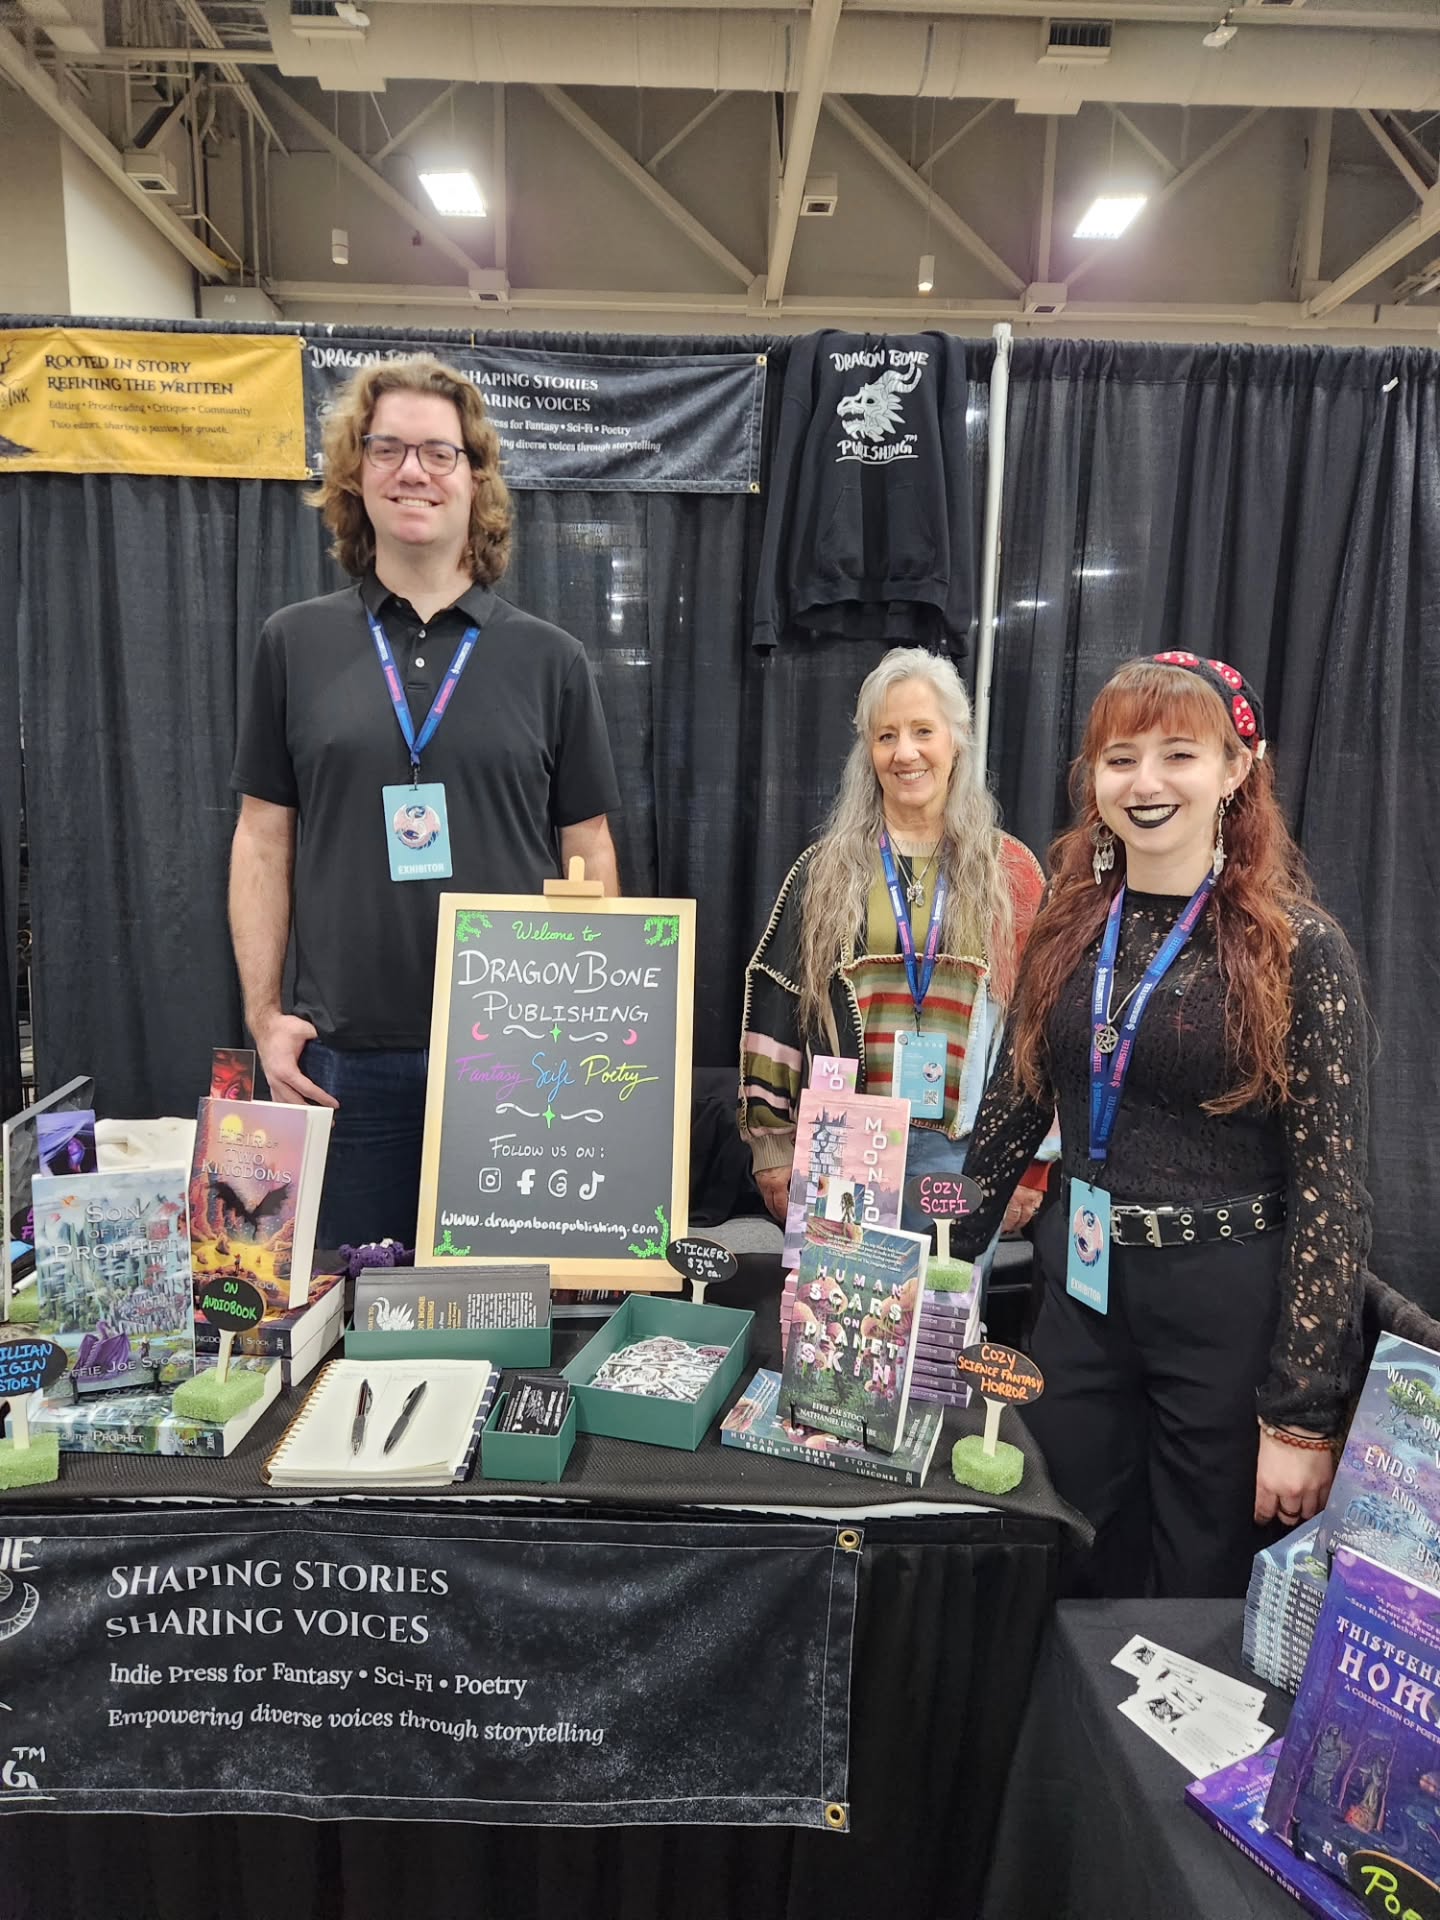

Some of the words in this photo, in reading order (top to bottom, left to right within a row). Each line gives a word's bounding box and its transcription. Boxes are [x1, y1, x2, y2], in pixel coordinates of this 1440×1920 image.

[44, 354, 109, 370] ROOTED
[113, 358, 132, 370] IN
[137, 359, 191, 374] STORY
[307, 345, 379, 370] DRAGON
[829, 350, 886, 373] DRAGON
[888, 349, 930, 368] BONE
[47, 376, 122, 392] REFINING
[123, 377, 156, 392] THE
[160, 378, 233, 395] WRITTEN
[461, 370, 530, 388] SHAPING
[532, 374, 599, 391] STORIES
[8, 386, 30, 407] INK
[481, 392, 531, 410] ARING
[534, 395, 591, 412] VOICES
[48, 400, 80, 412] Editing
[88, 401, 145, 416] Proofreading
[153, 403, 189, 417] Critique
[198, 406, 252, 419] Community
[509, 417, 524, 430] for
[525, 419, 560, 435] Fantasy
[567, 422, 593, 434] Sci-Fi
[601, 424, 632, 436] Poetry
[515, 438, 547, 451] diverse
[549, 441, 576, 452] voices
[577, 441, 611, 454] through
[612, 438, 662, 454] storytelling
[398, 863, 445, 875] EXHIBITOR
[512, 921, 576, 942] Welcome
[582, 924, 602, 942] to
[457, 949, 580, 986] DRAGON
[574, 950, 662, 994] BONE
[472, 990, 649, 1024] PUBLISHING
[455, 1053, 534, 1100] Fantasy
[580, 1054, 660, 1101] Poetry
[217, 1128, 264, 1149] HEIR
[489, 1133, 544, 1159] FOLLOW
[551, 1145, 568, 1158] US
[224, 1147, 265, 1166] TWO
[201, 1158, 292, 1185] KINGDOMS
[85, 1203, 143, 1223] SON
[87, 1228, 109, 1240] OF
[114, 1225, 147, 1239] THE
[440, 1210, 660, 1241] www.dragonbonepublishing.com
[53, 1239, 178, 1263] PROPHET
[675, 1240, 731, 1264] STICKERS
[223, 1281, 239, 1295] ON
[817, 1263, 904, 1299] HUMAN
[202, 1294, 257, 1321] AUDIOBOOK
[809, 1283, 902, 1321] SCARS
[843, 1316, 860, 1329] ON
[0, 1344, 53, 1361] ILLIAN
[805, 1321, 900, 1360] PLANET
[0, 1357, 46, 1378] IGIN
[107, 1360, 136, 1373] JOE
[801, 1342, 891, 1386] SKIN
[981, 1344, 1017, 1371] COZY
[957, 1355, 1000, 1378] SCIENCE
[1001, 1368, 1043, 1394] FANTASY
[1386, 1363, 1426, 1406] WHEN
[980, 1376, 1029, 1401] HORROR
[800, 1409, 841, 1426] NATHANIEL
[841, 1420, 877, 1438] LUSCOBE
[829, 1408, 842, 1416] JOE
[93, 1430, 144, 1444] PROPHET
[731, 1432, 774, 1447] HUMAN
[745, 1441, 780, 1455] SCARS
[793, 1445, 832, 1460] PLANET
[805, 1456, 836, 1469] SKIN
[845, 1457, 878, 1470] STOCK
[856, 1467, 898, 1482] LUSCOMBE
[1364, 1446, 1420, 1490] ENDS,
[106, 1559, 283, 1599] SHAPING
[292, 1560, 450, 1596] STORIES
[105, 1606, 284, 1638] SHARING
[294, 1609, 430, 1645] VOICES
[1336, 1615, 1440, 1688] THISTLEHE
[109, 1662, 163, 1685] Indie
[168, 1664, 228, 1684] Press
[233, 1663, 267, 1683] for
[272, 1662, 353, 1690] Fantasy
[374, 1666, 433, 1693] Sci-Fi
[454, 1674, 527, 1700] Poetry
[108, 1706, 244, 1730] Empowering
[250, 1703, 322, 1729] diverse
[328, 1707, 394, 1728] voices
[399, 1710, 478, 1742] through
[484, 1718, 604, 1746] storytelling
[1351, 1685, 1403, 1721] COLLECTION
[1403, 1718, 1415, 1729] OF
[1415, 1725, 1440, 1745] POET
